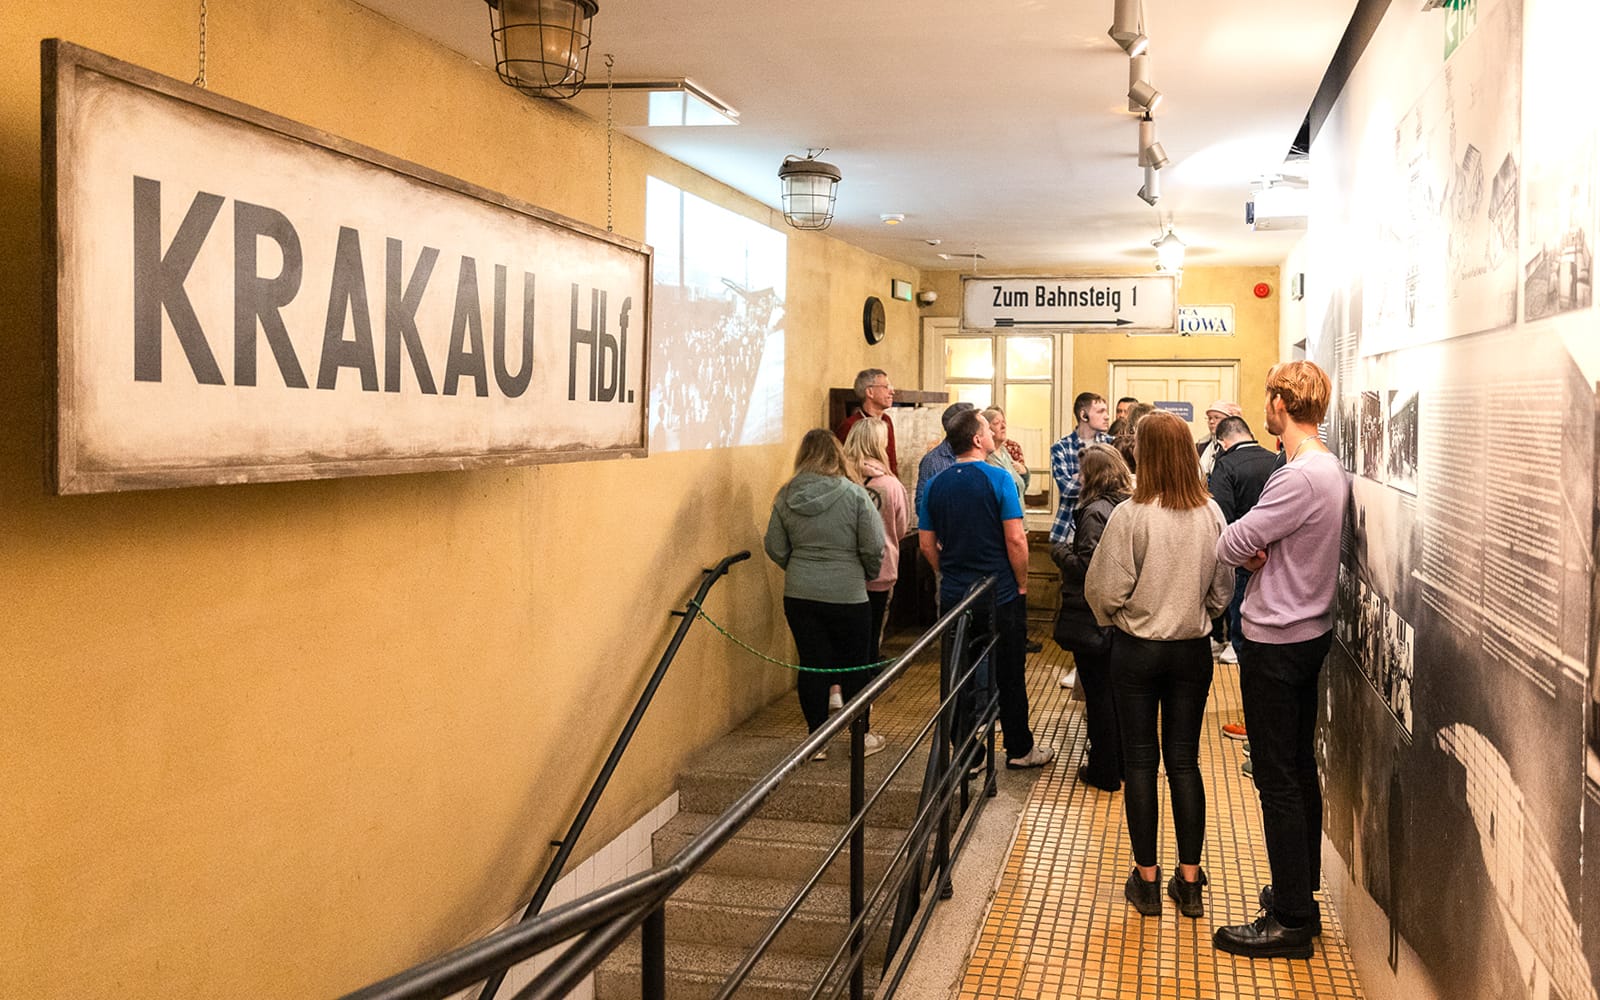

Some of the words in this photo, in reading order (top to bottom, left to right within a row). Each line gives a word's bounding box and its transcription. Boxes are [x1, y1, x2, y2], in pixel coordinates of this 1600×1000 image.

[133, 175, 535, 398] KRAKAU
[568, 282, 634, 403] Hbf.
[992, 285, 1029, 307] Zum
[1035, 285, 1121, 313] Bahnsteig
[1131, 285, 1137, 306] 1
